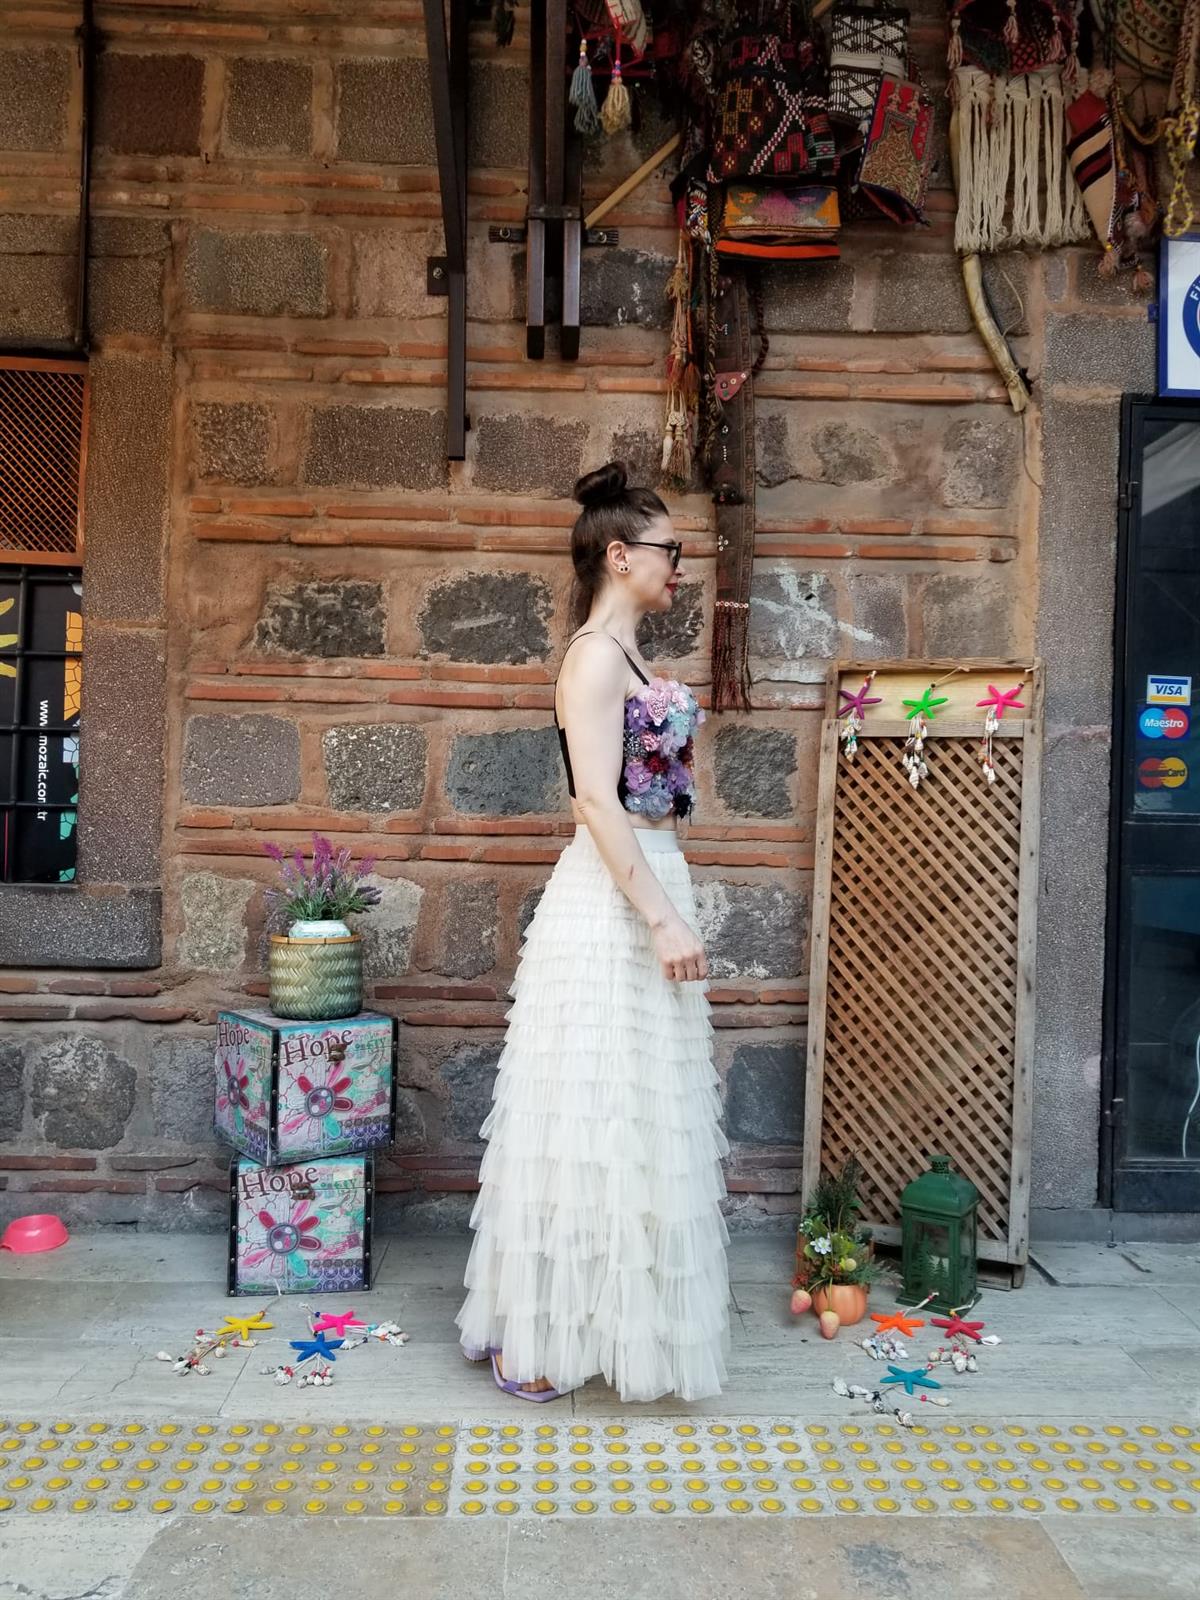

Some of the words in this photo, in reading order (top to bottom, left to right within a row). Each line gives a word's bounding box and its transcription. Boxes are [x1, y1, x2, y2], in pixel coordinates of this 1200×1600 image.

[1155, 685, 1183, 696] VISA
[1144, 718, 1184, 729] Maestro
[218, 1022, 250, 1055] Hope
